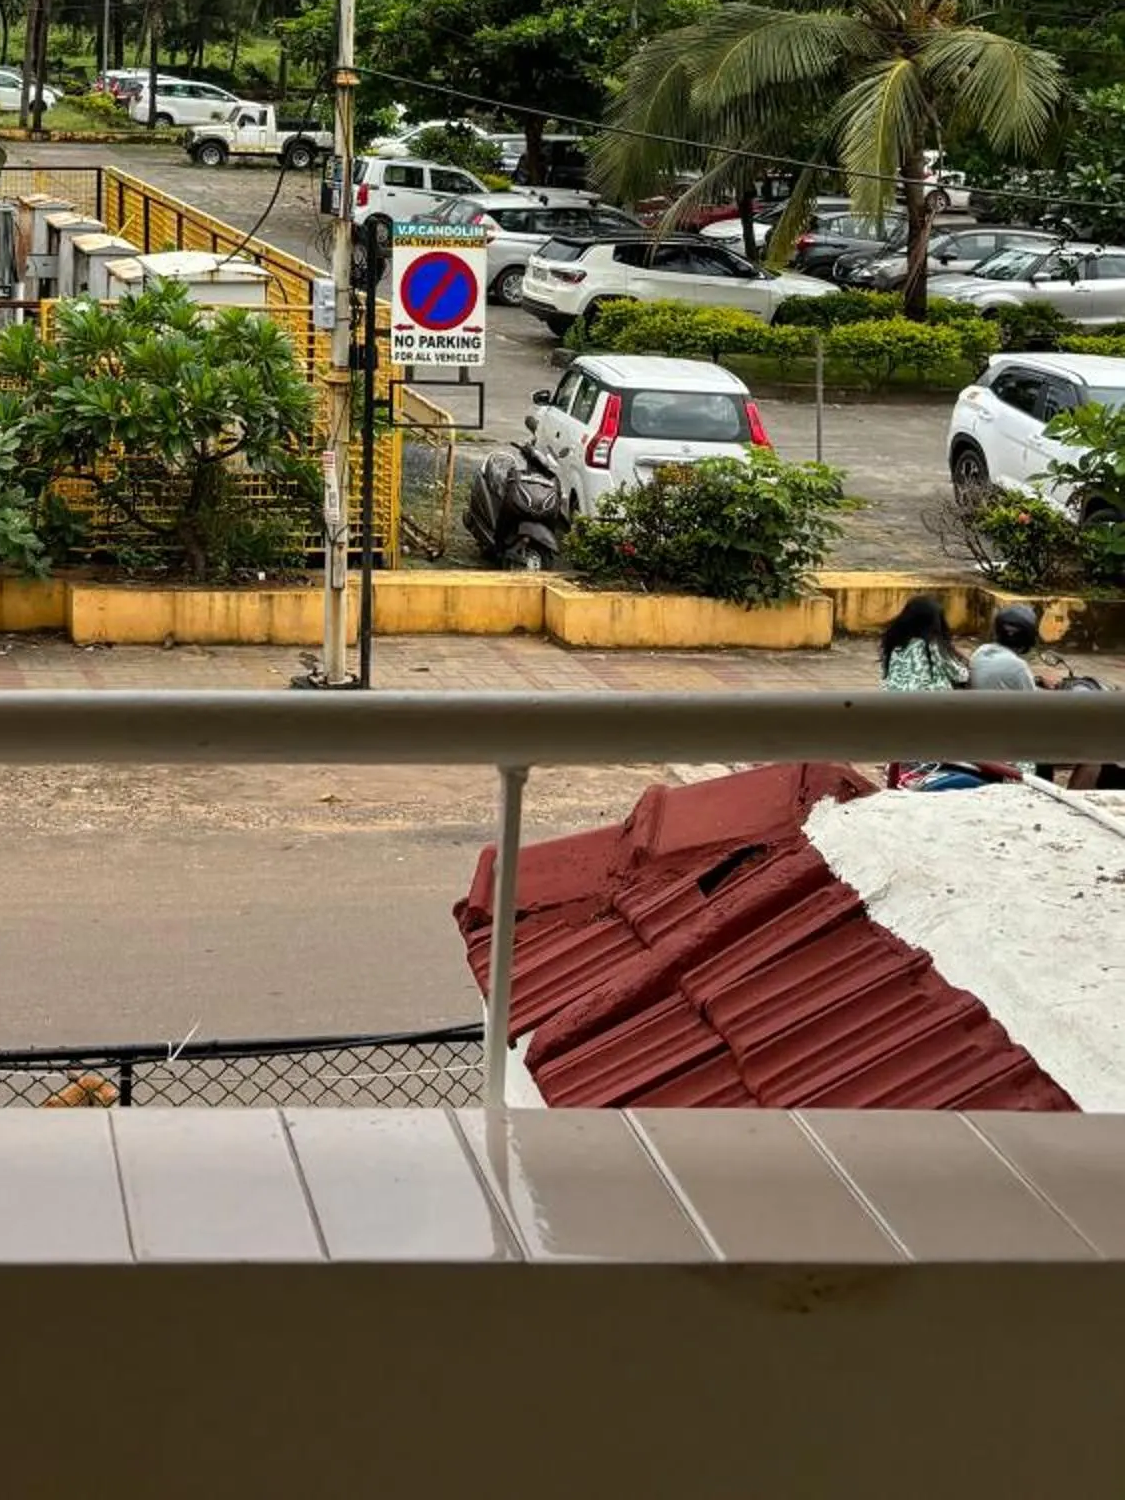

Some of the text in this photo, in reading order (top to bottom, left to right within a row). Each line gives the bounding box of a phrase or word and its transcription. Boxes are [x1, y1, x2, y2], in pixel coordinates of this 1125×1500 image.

[394, 238, 484, 248] GOA TRAFFIC POLICE
[394, 335, 481, 349] NO PARKING
[394, 351, 480, 363] FOR ALL VEHICLES
